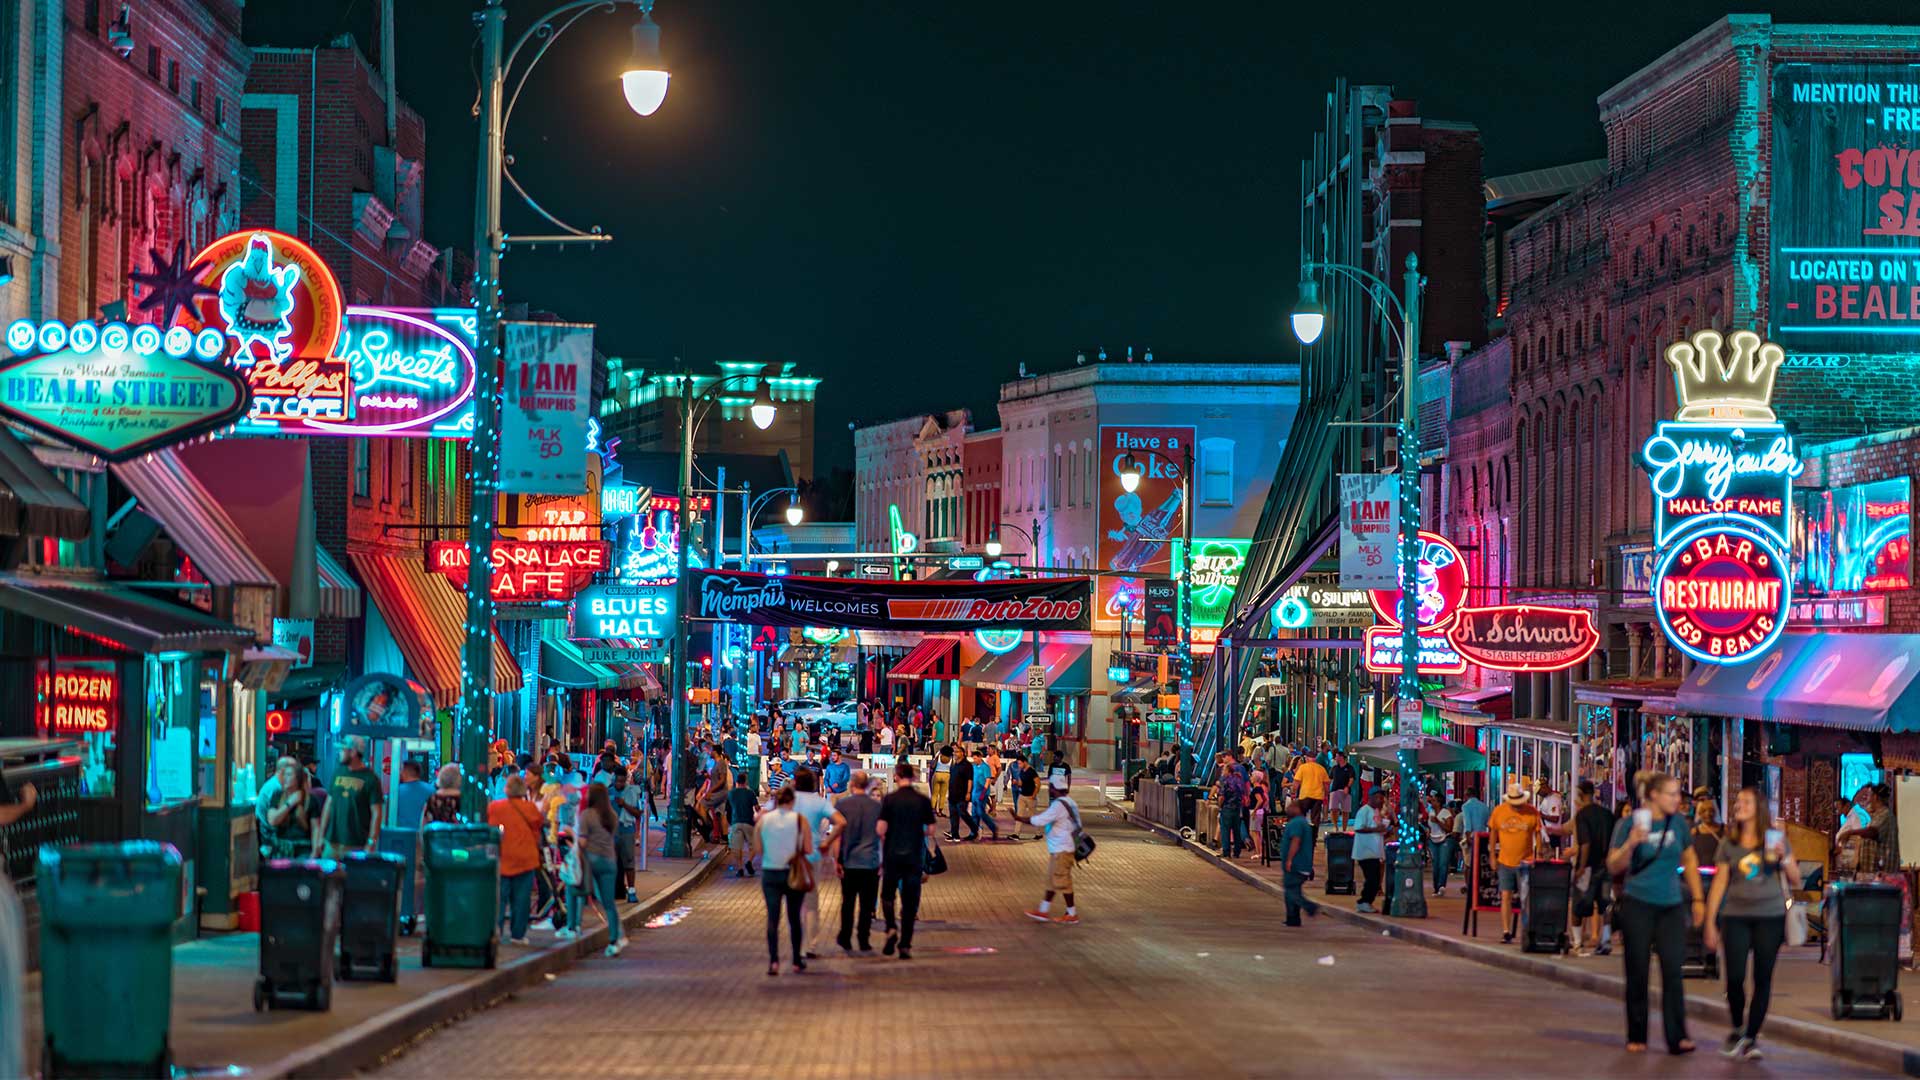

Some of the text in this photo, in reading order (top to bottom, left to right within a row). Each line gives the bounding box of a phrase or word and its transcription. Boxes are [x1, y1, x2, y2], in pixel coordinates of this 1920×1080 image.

[1793, 83, 1920, 103] MENTION THI
[1790, 260, 1874, 280] LOCATED
[1880, 260, 1907, 281] ON
[1815, 284, 1920, 320] BEALE
[8, 322, 224, 356] WELCOME
[356, 331, 455, 390] Sweets
[77, 364, 117, 377] World
[120, 364, 166, 378] Famous
[249, 360, 344, 398] Polly's
[520, 362, 577, 391] I AM
[8, 377, 224, 408] BEALE STREET
[283, 397, 343, 418] CAFE
[519, 396, 577, 411] MEMPHIS
[528, 428, 561, 441] MLK
[1116, 431, 1179, 449] Have a
[539, 441, 563, 459] 50
[1112, 452, 1180, 479] Coke
[1645, 436, 1734, 501] Jerry
[1351, 501, 1390, 520] I AM
[1668, 499, 1782, 513] HALL OF FAME
[545, 509, 586, 526] TAP
[1351, 523, 1391, 534] MEMPHIS
[439, 548, 506, 568] KINS
[1358, 544, 1382, 554] MLK
[1695, 533, 1753, 564] BAR
[1366, 554, 1383, 567] 50
[491, 570, 565, 595] AFE
[701, 584, 1082, 621] Memphis WELCOMES AutoZone
[1664, 579, 1780, 611] RESTAURANT
[591, 597, 668, 616] BLUES
[599, 618, 660, 636] HALL
[1486, 613, 1590, 644] Schwab
[1672, 615, 1775, 656] 159 BEALE
[589, 651, 658, 661] JUKE JOINT
[1371, 650, 1392, 664] AN
[1480, 650, 1569, 662] ESTABLISHED 1876
[1029, 677, 1044, 687] 25
